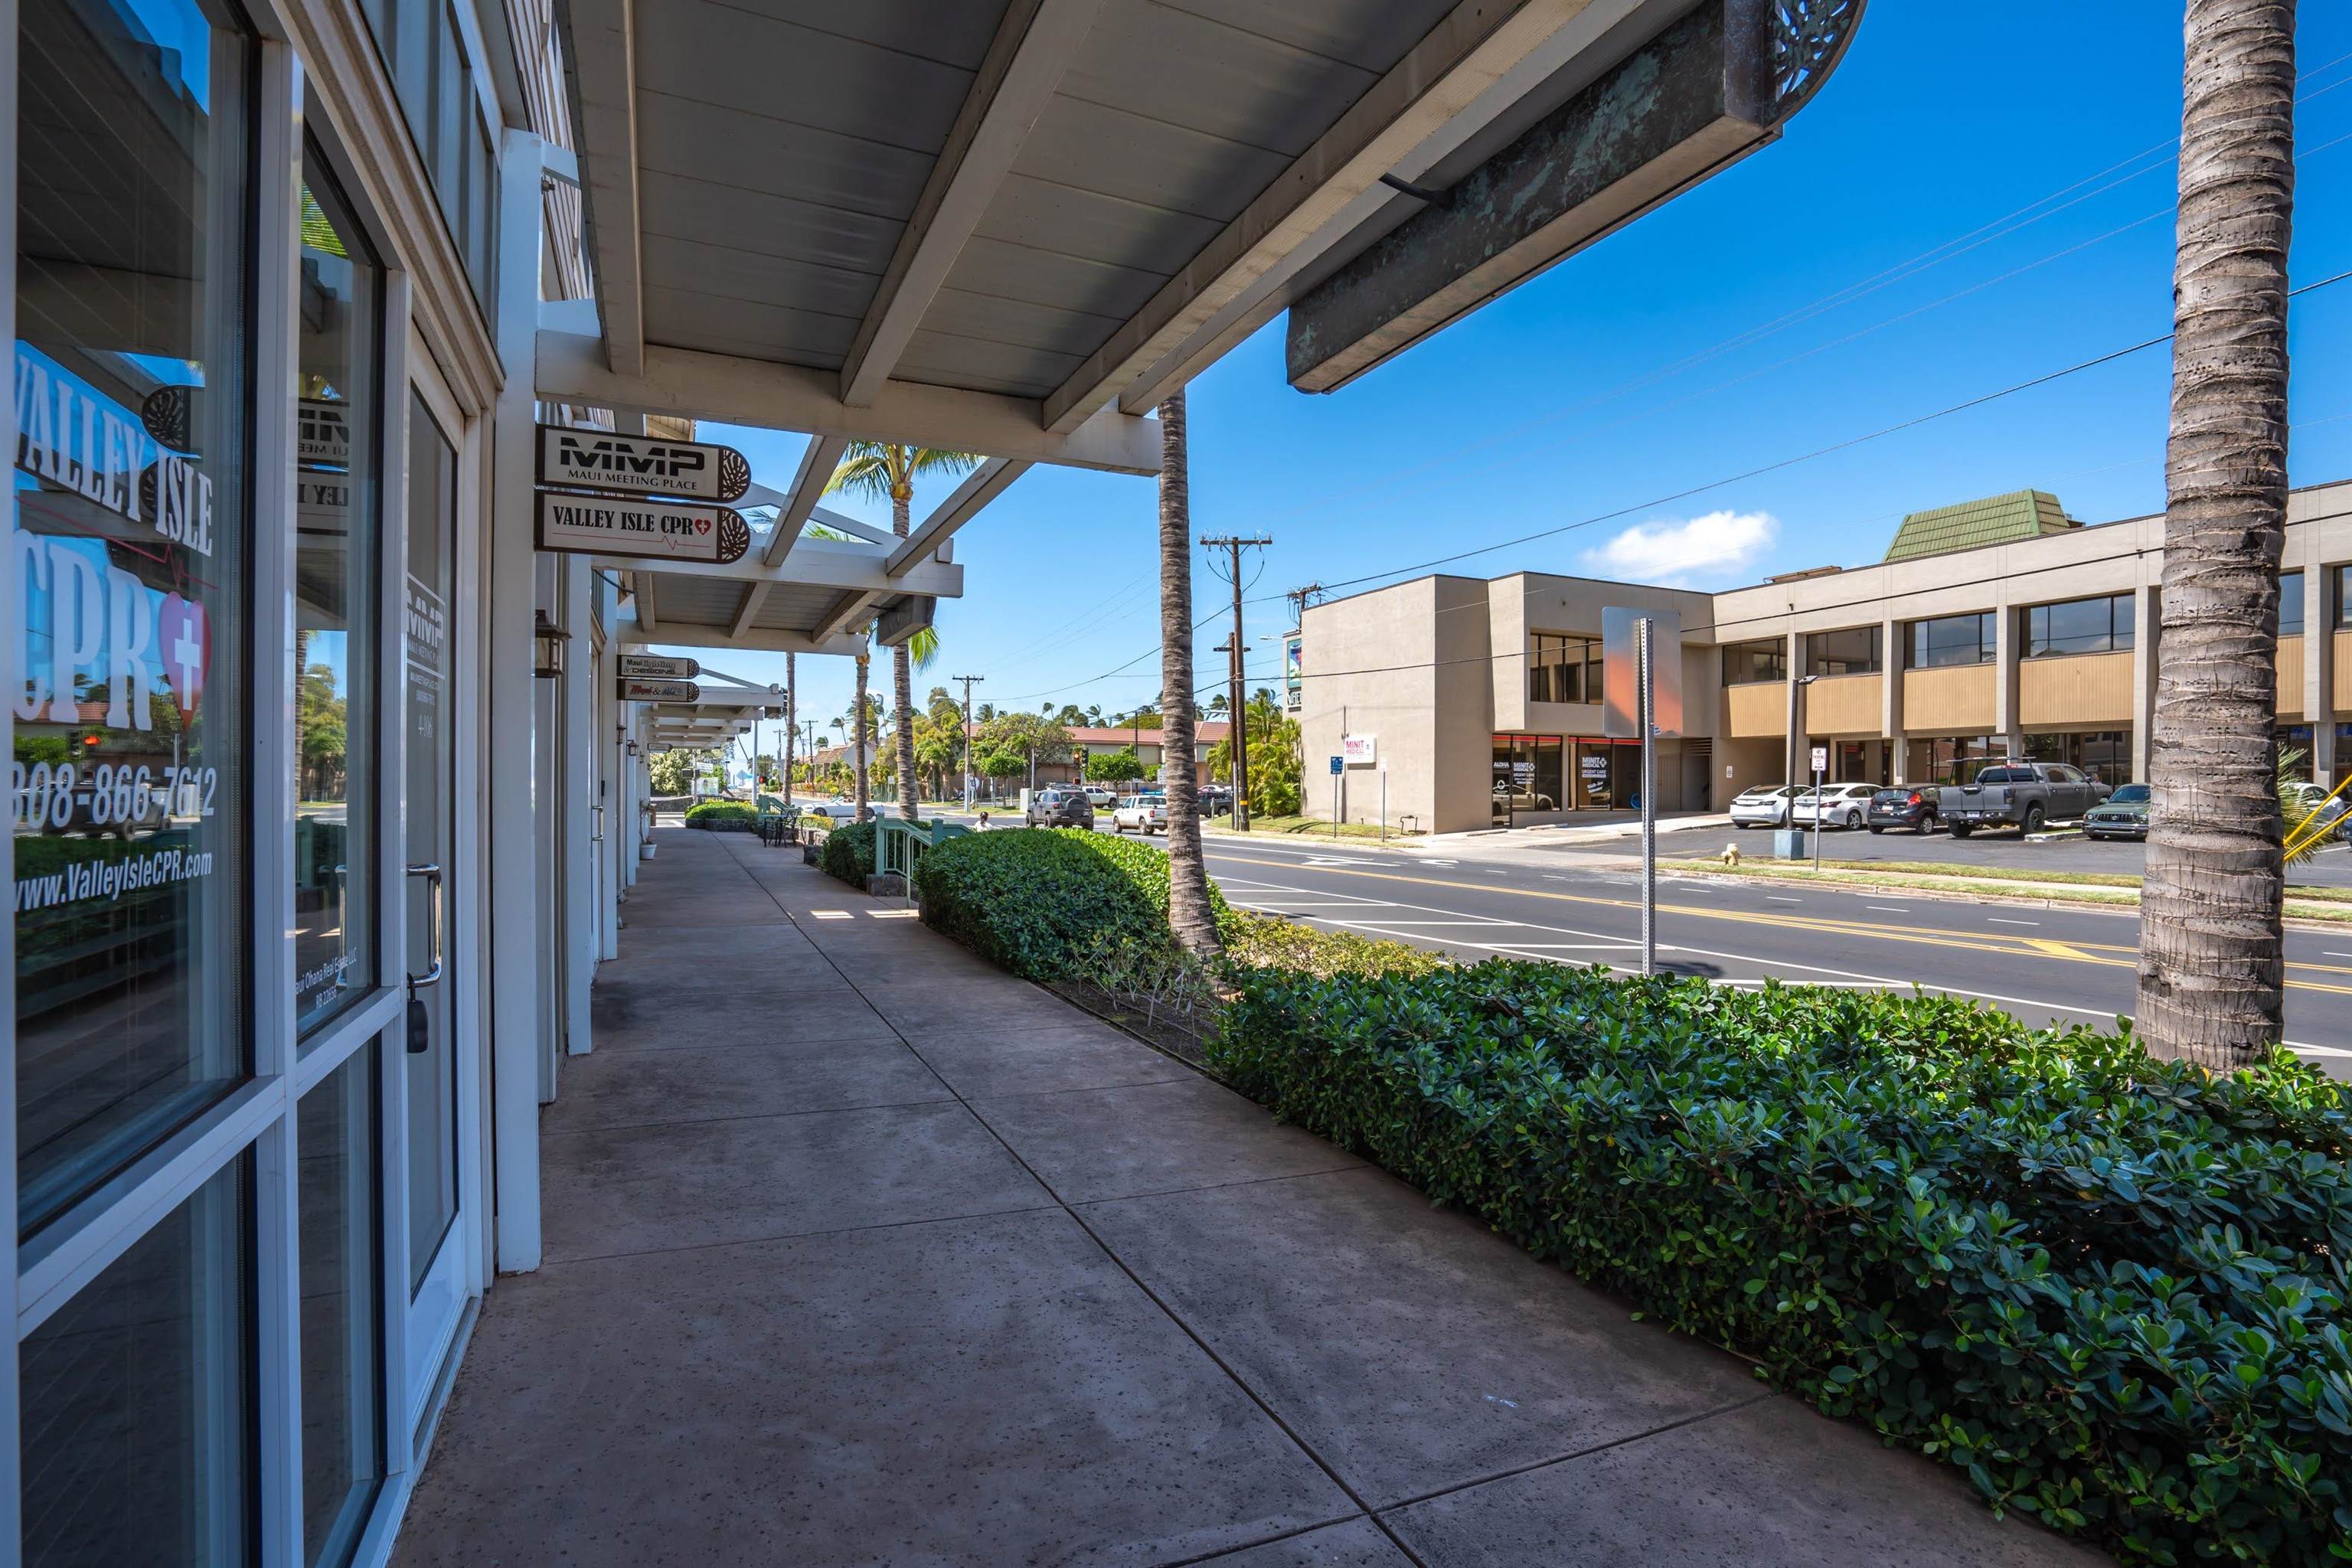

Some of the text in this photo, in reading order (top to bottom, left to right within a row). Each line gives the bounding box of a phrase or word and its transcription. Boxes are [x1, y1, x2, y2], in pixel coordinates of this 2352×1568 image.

[560, 436, 704, 476] MMP
[567, 469, 697, 491] MAUI MEETING PLACE
[155, 446, 213, 557] ISLE
[552, 505, 693, 535] VALLEY ISLE CPR
[13, 528, 152, 730] CPR
[1346, 740, 1364, 749] MINIT
[295, 974, 305, 995] aui
[305, 969, 322, 988] Ohana
[323, 958, 335, 979] Real
[348, 946, 357, 965] LLC
